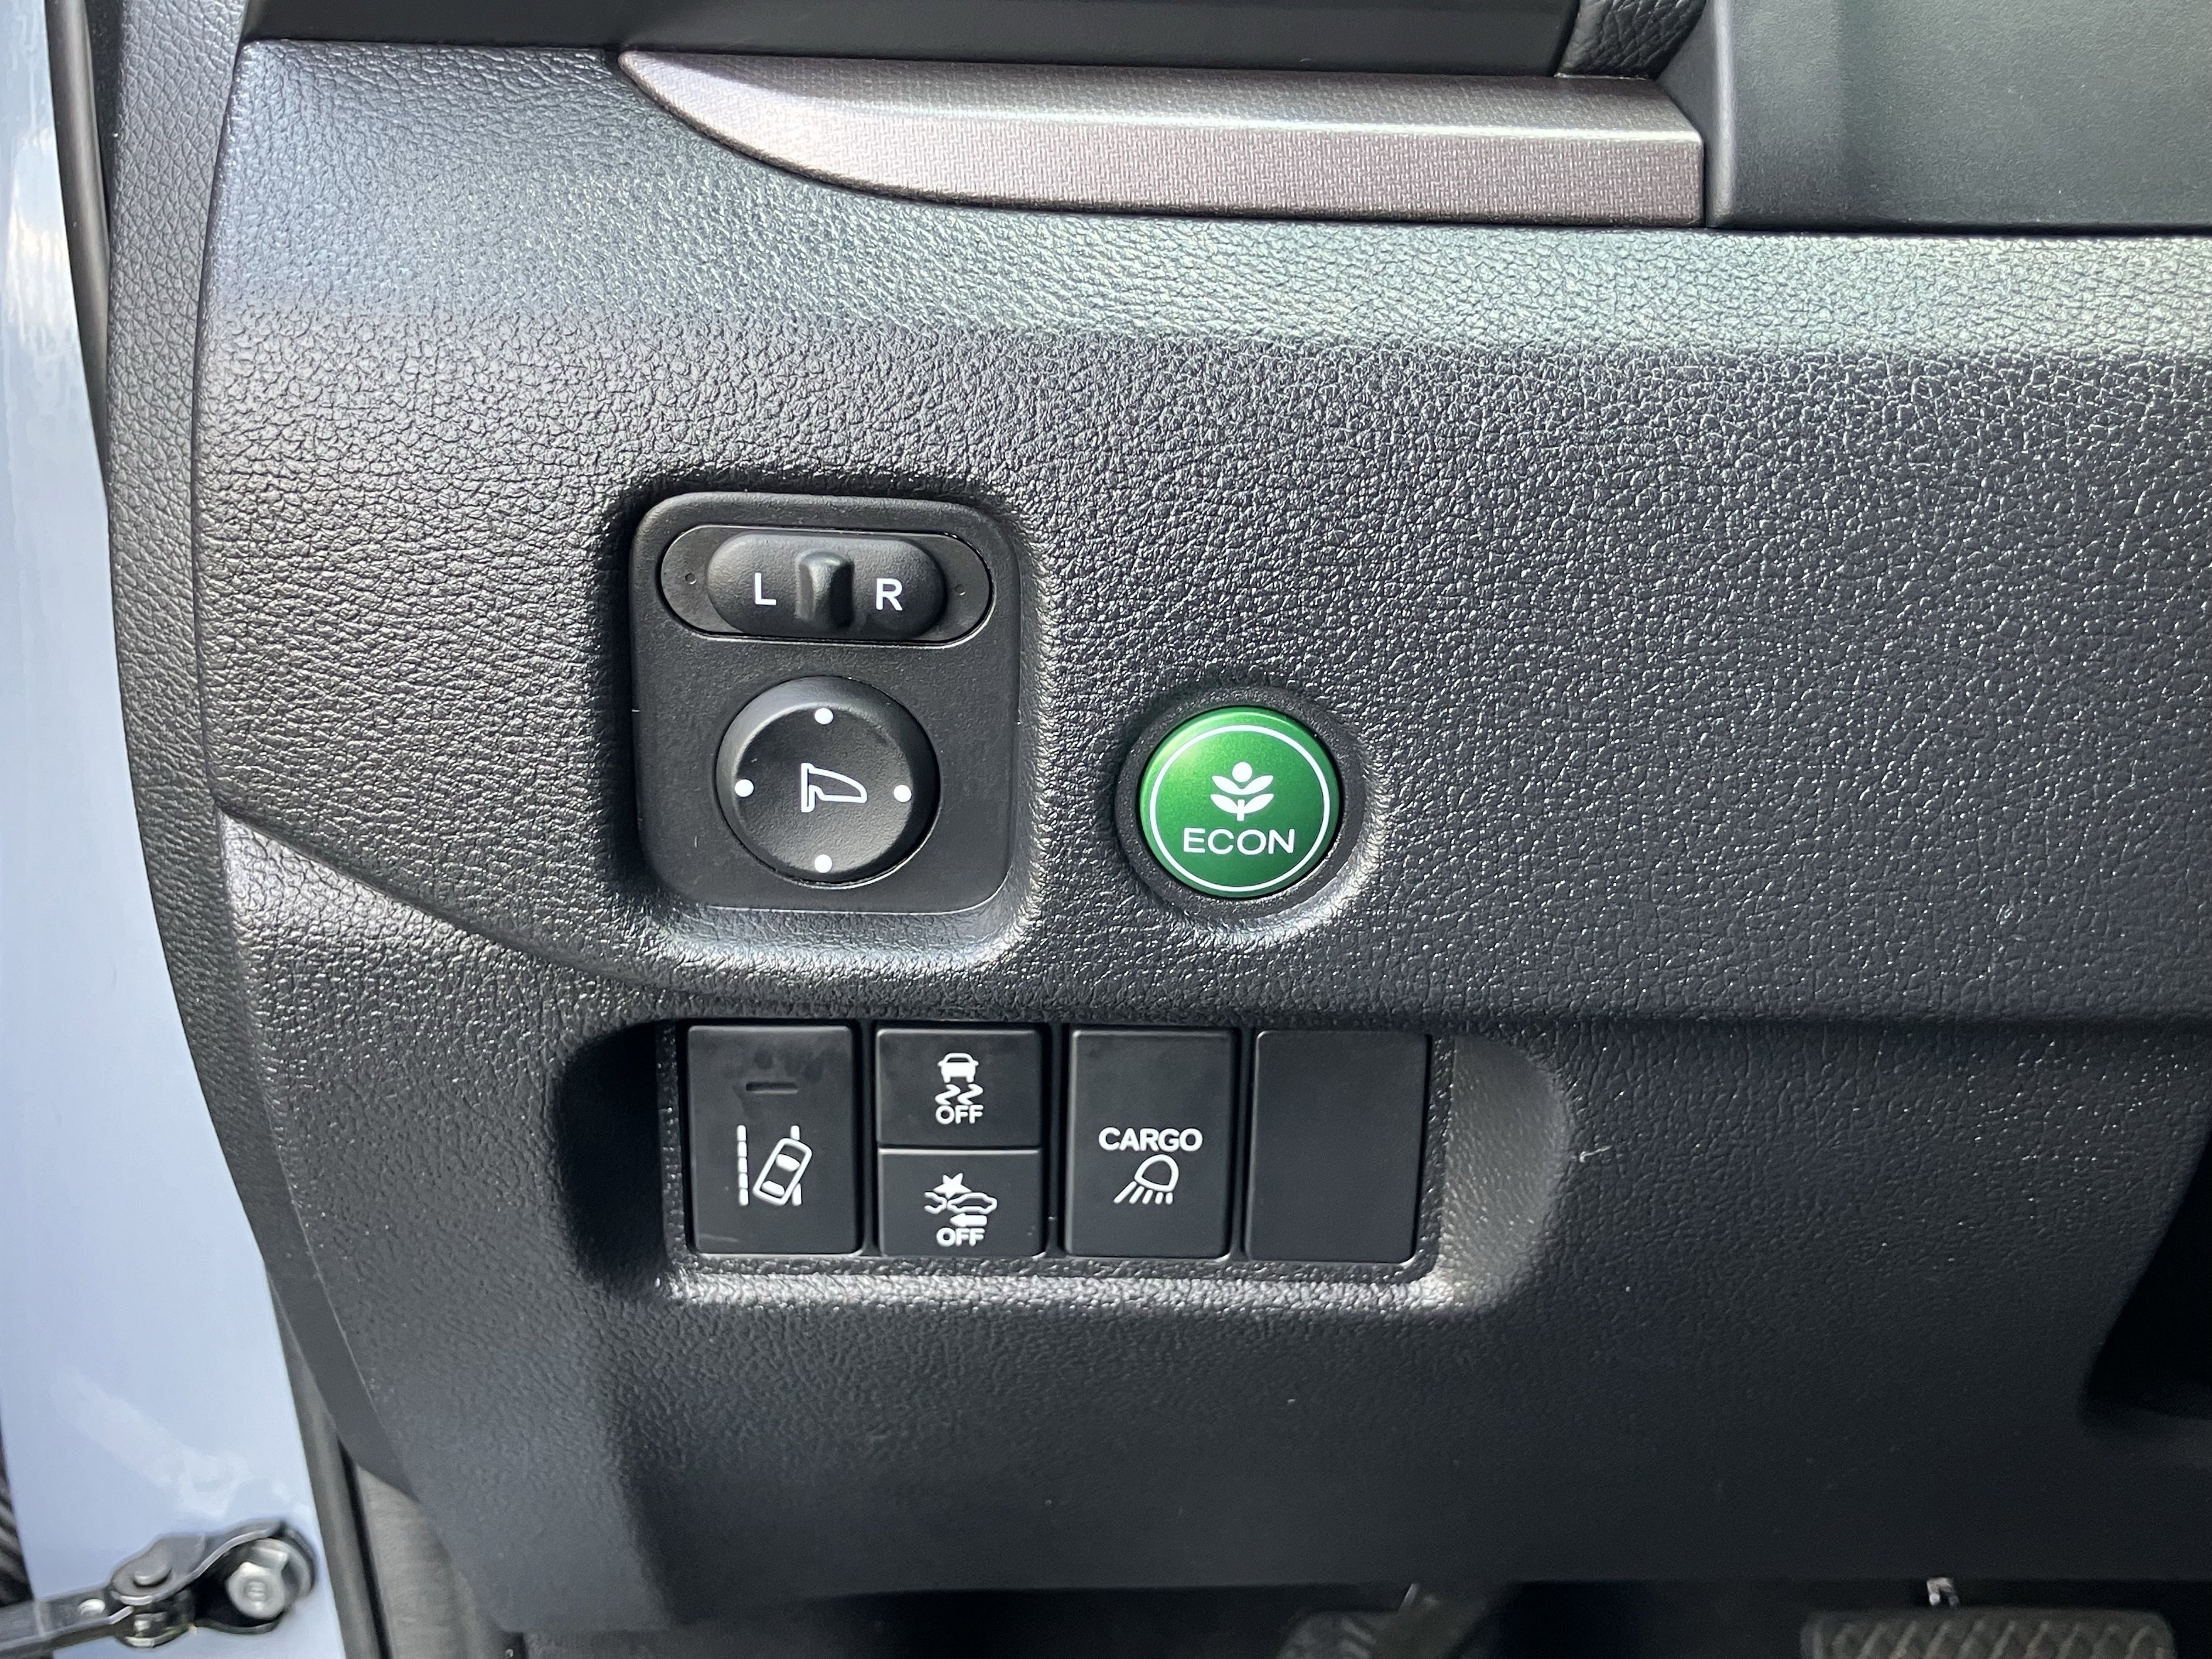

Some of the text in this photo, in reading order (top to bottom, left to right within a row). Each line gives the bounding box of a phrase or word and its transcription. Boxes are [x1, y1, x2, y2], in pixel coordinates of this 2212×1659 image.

[754, 572, 777, 606] L
[876, 577, 902, 611] R
[1183, 827, 1295, 855] ECON
[935, 1104, 984, 1125] OFF
[1098, 1126, 1203, 1152] CARGO
[936, 1227, 985, 1247] OFF
